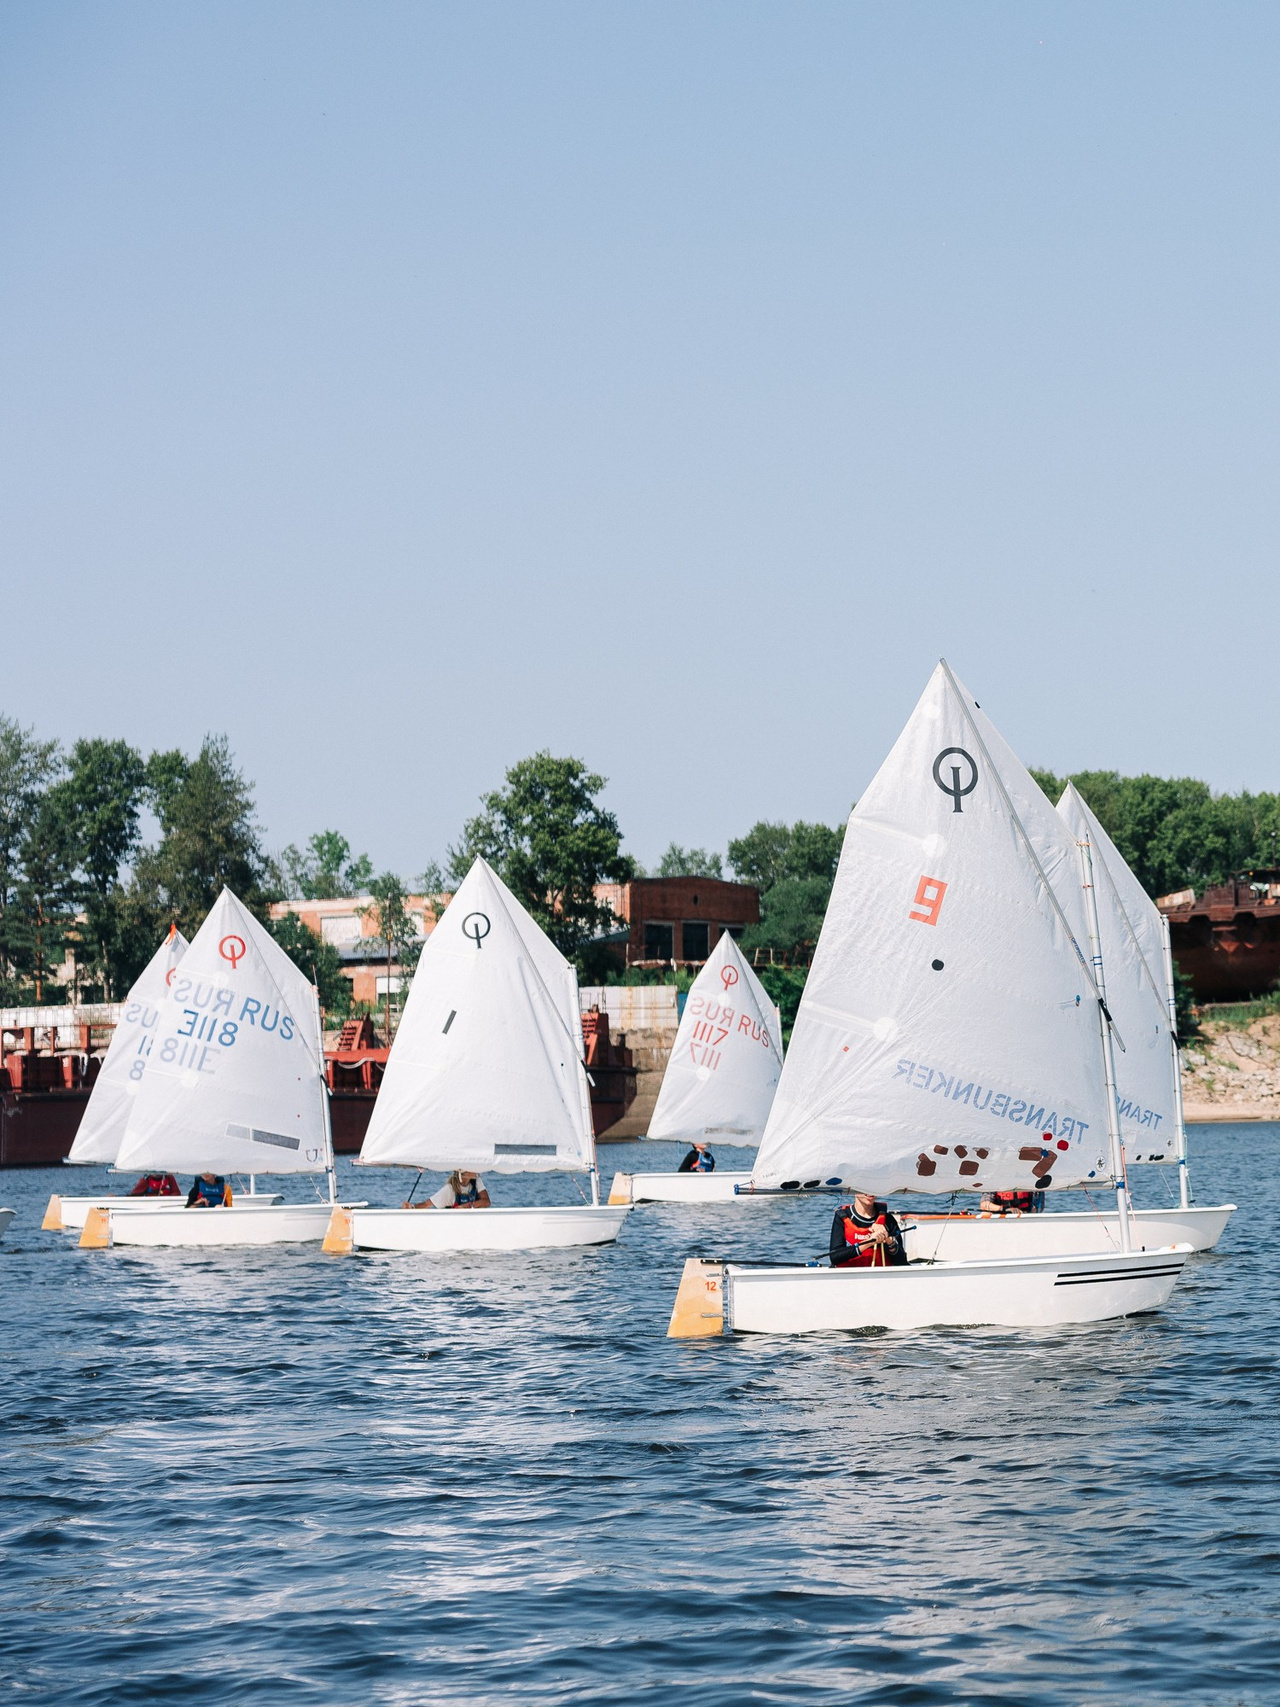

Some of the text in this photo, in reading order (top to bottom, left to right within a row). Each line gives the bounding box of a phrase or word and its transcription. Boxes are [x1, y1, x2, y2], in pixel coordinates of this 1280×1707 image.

[908, 874, 948, 926] 9
[239, 996, 295, 1040] RUS
[692, 1020, 729, 1046] 1117
[738, 1013, 769, 1048] RUS
[705, 1281, 717, 1292] 12
